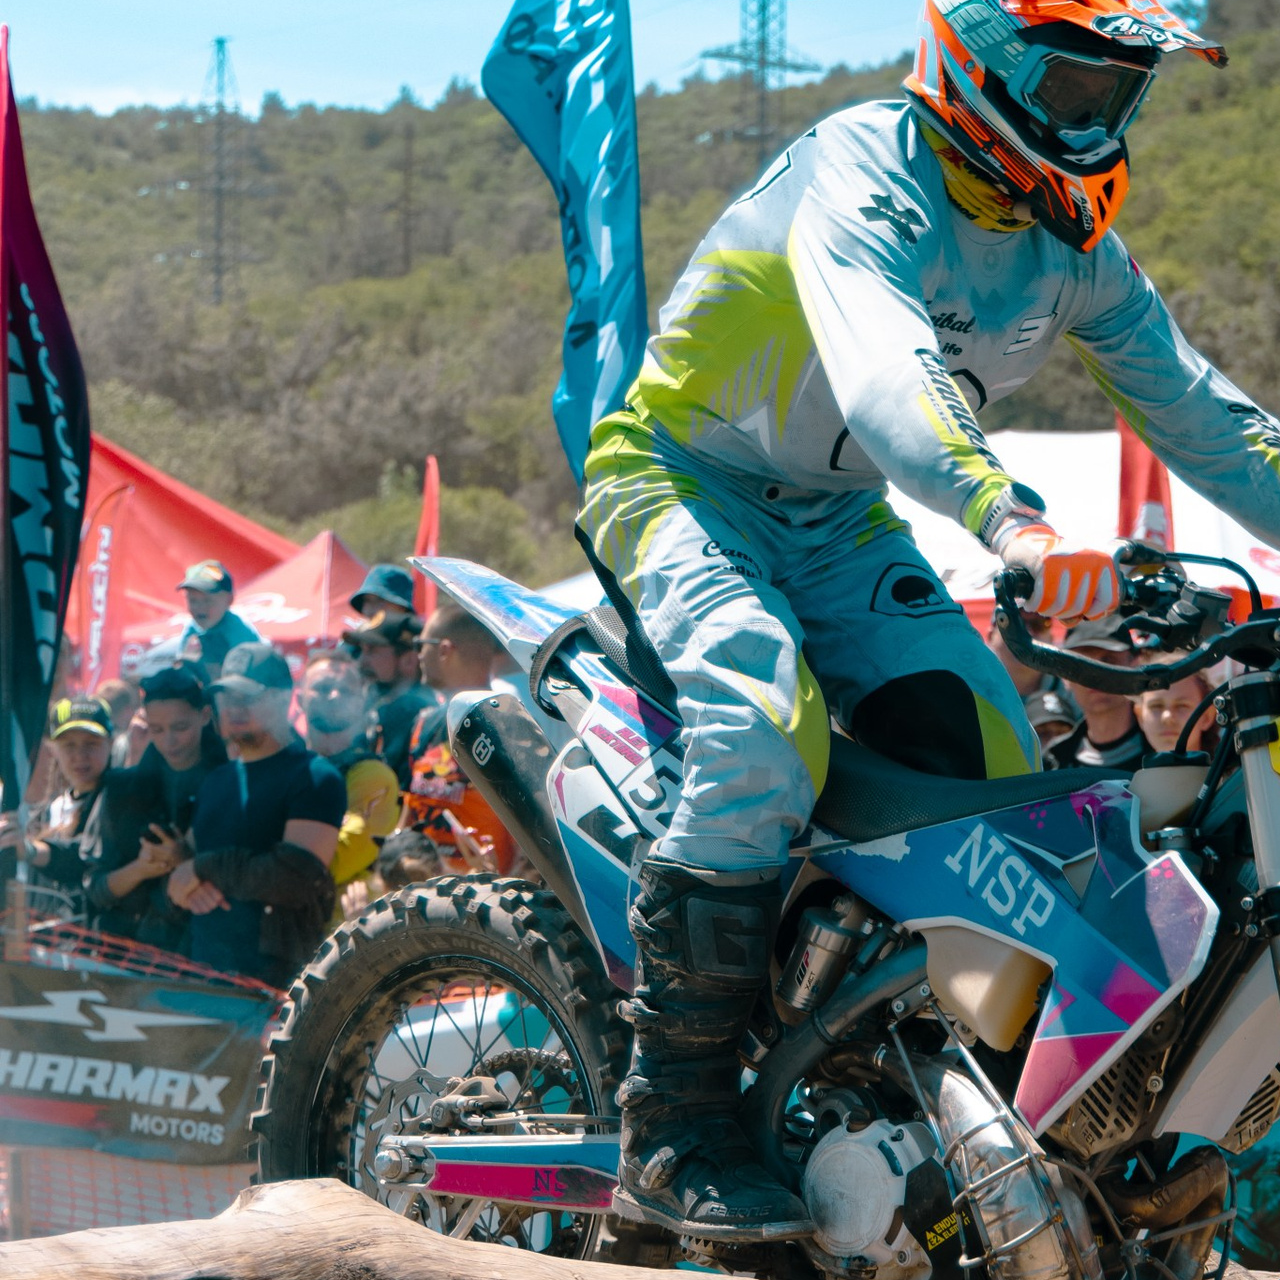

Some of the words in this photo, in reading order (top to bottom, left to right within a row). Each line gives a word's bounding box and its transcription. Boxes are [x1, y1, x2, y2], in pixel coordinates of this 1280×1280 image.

[1080, 195, 1093, 231] Airoh
[944, 823, 1055, 936] NSP
[130, 1112, 226, 1146] MOTORS
